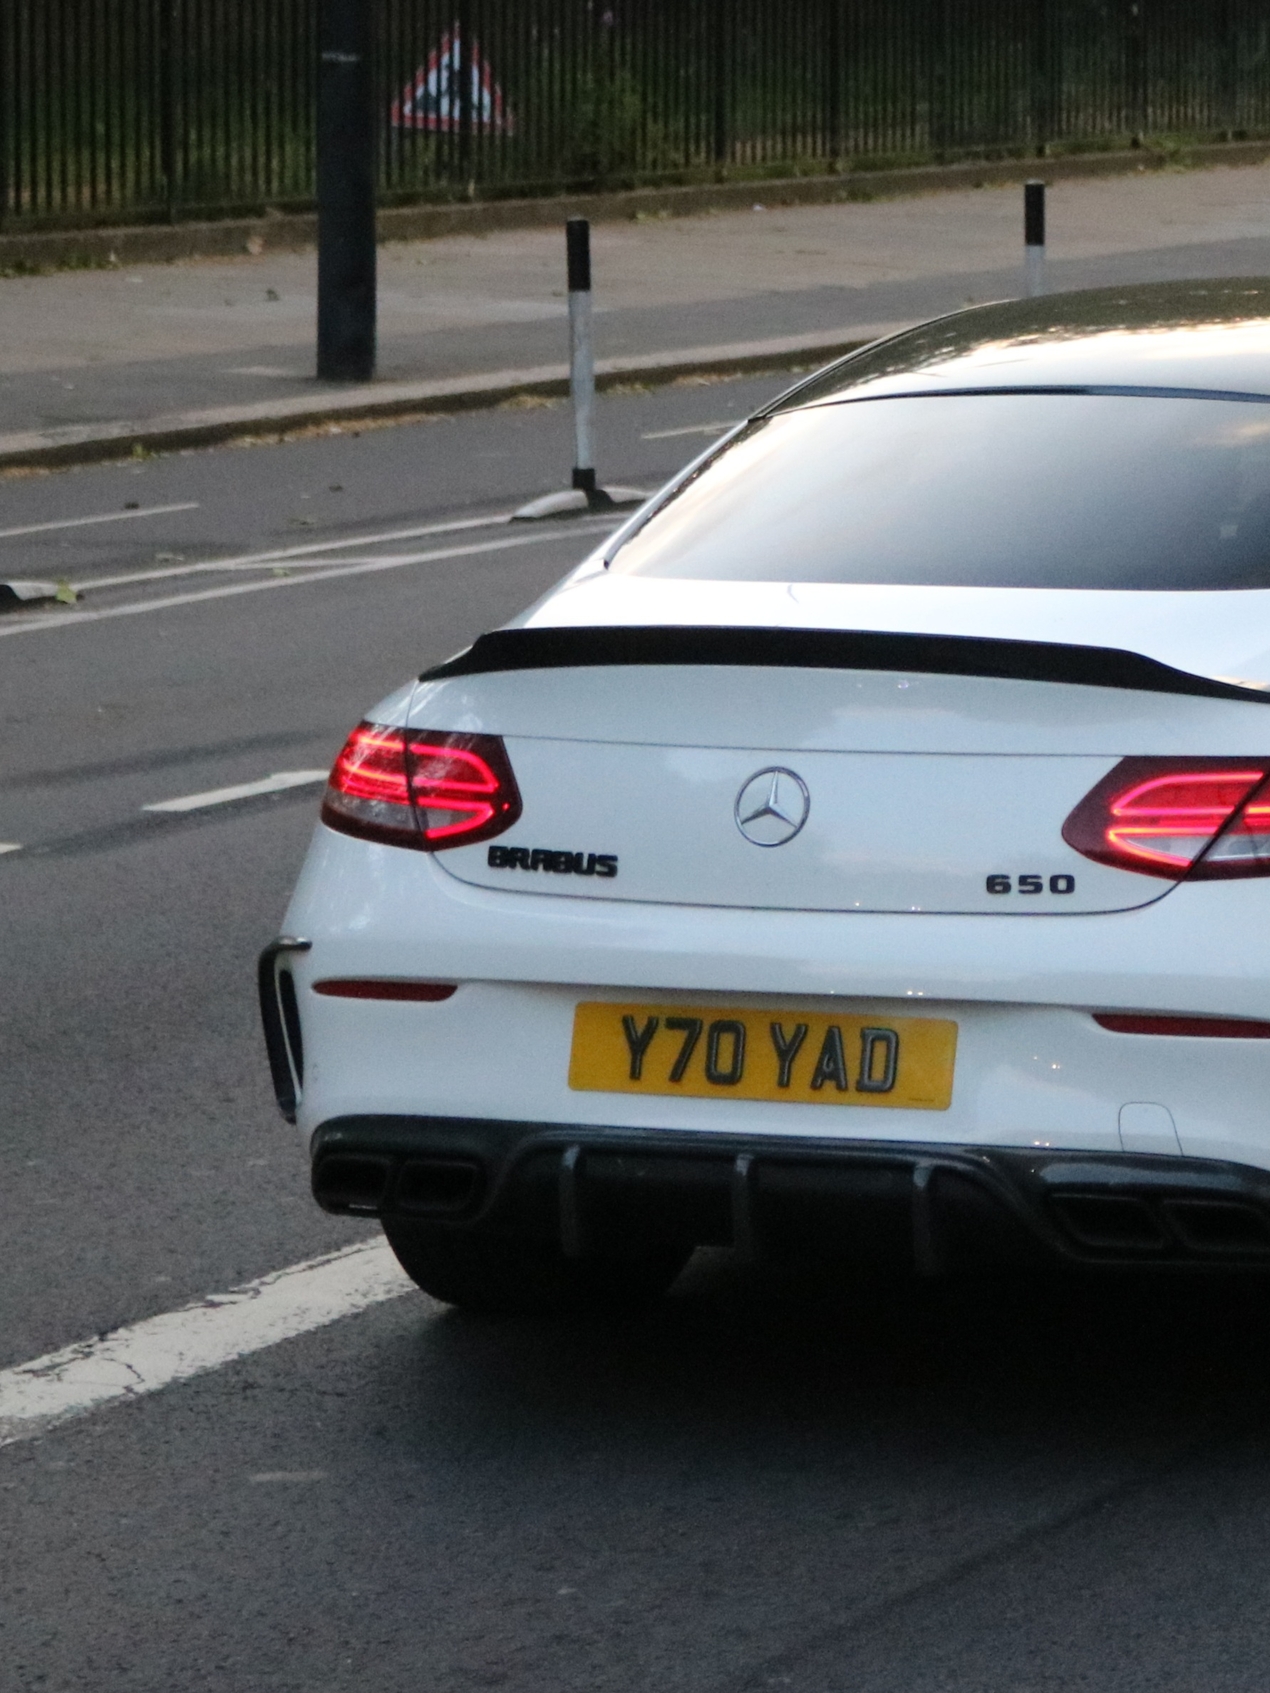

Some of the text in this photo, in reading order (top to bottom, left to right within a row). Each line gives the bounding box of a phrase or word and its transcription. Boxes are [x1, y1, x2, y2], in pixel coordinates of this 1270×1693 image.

[487, 845, 618, 877] BRABUS
[986, 873, 1076, 894] 650
[621, 1014, 900, 1094] Y70 YAD
